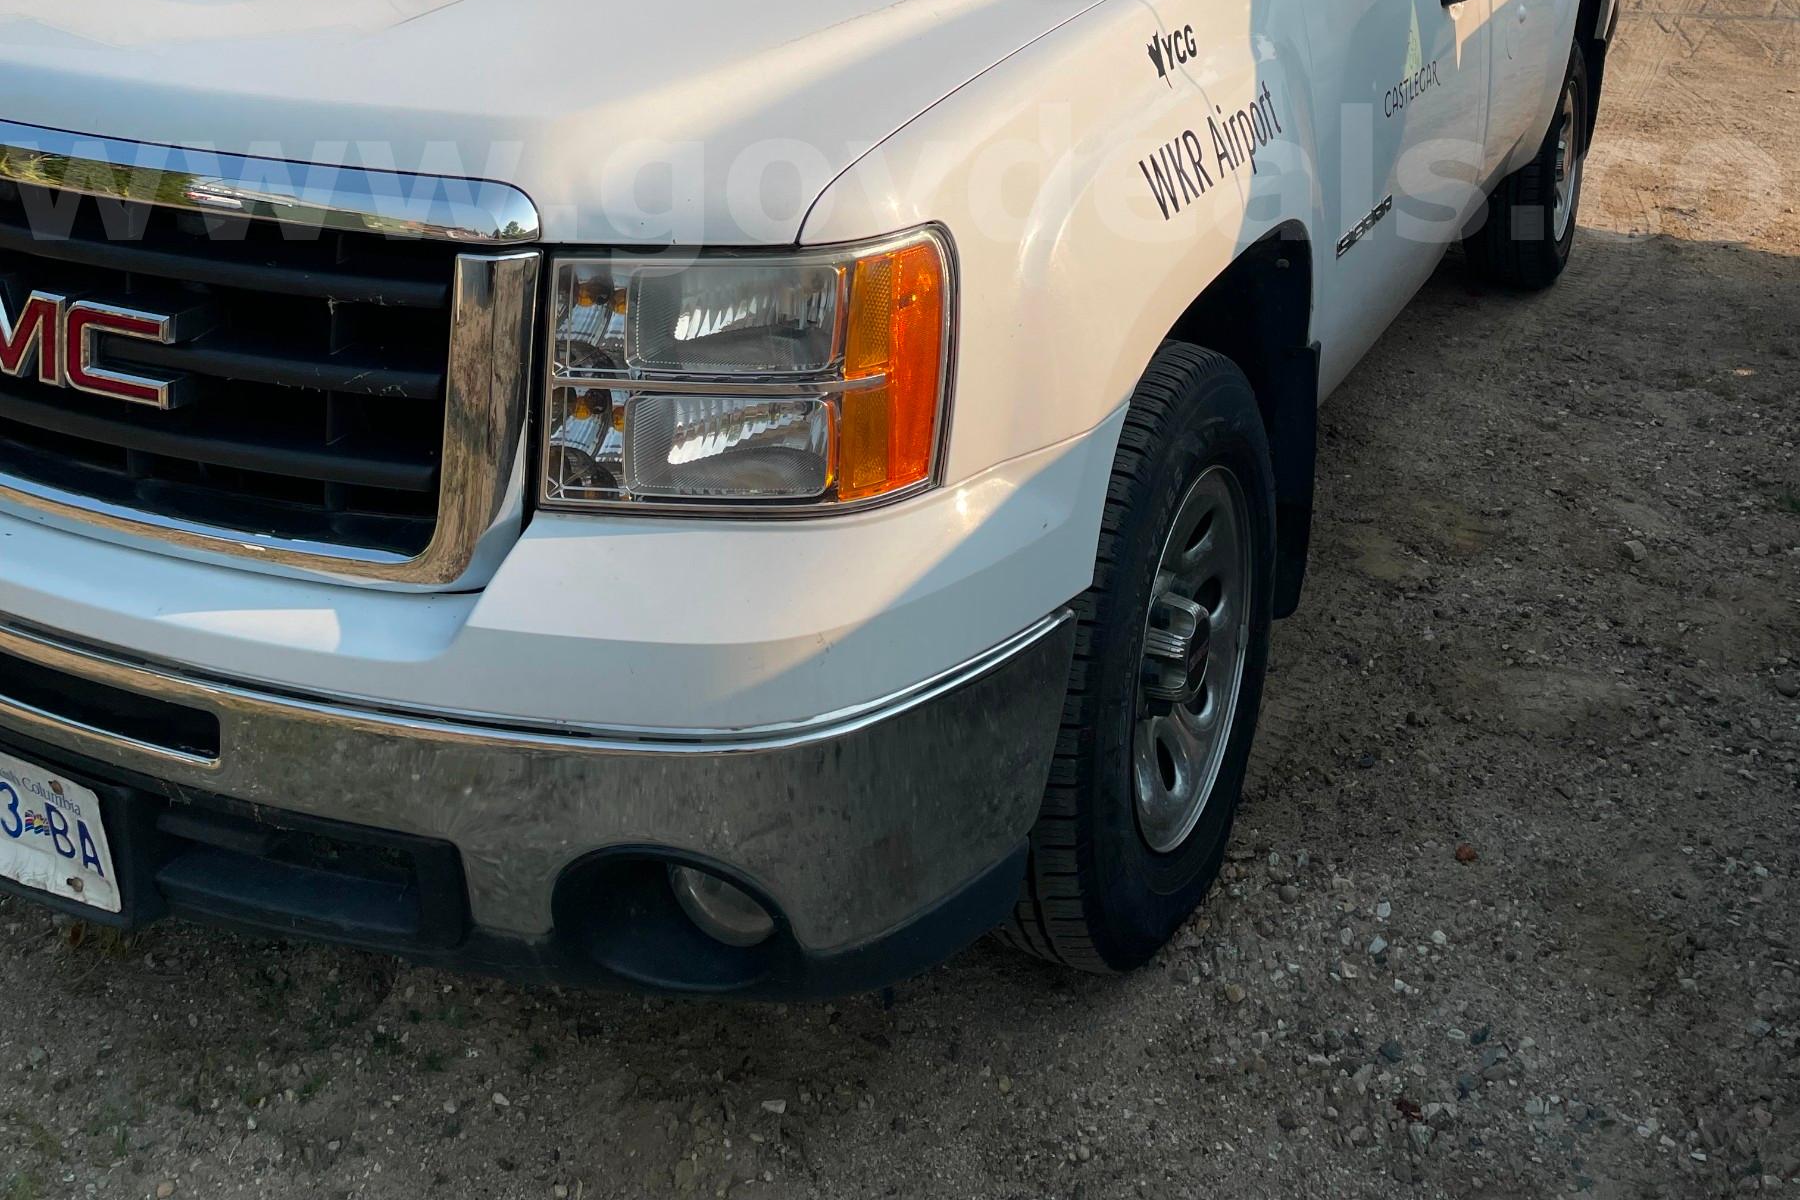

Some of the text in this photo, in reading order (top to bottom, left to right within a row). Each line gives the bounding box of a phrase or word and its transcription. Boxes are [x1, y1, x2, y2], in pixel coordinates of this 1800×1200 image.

[1161, 23, 1198, 71] YCG
[1384, 60, 1441, 118] CASTLEGAR
[1138, 80, 1282, 221] WKR Airport
[22, 777, 81, 816] Columbia
[45, 802, 104, 877] BA
